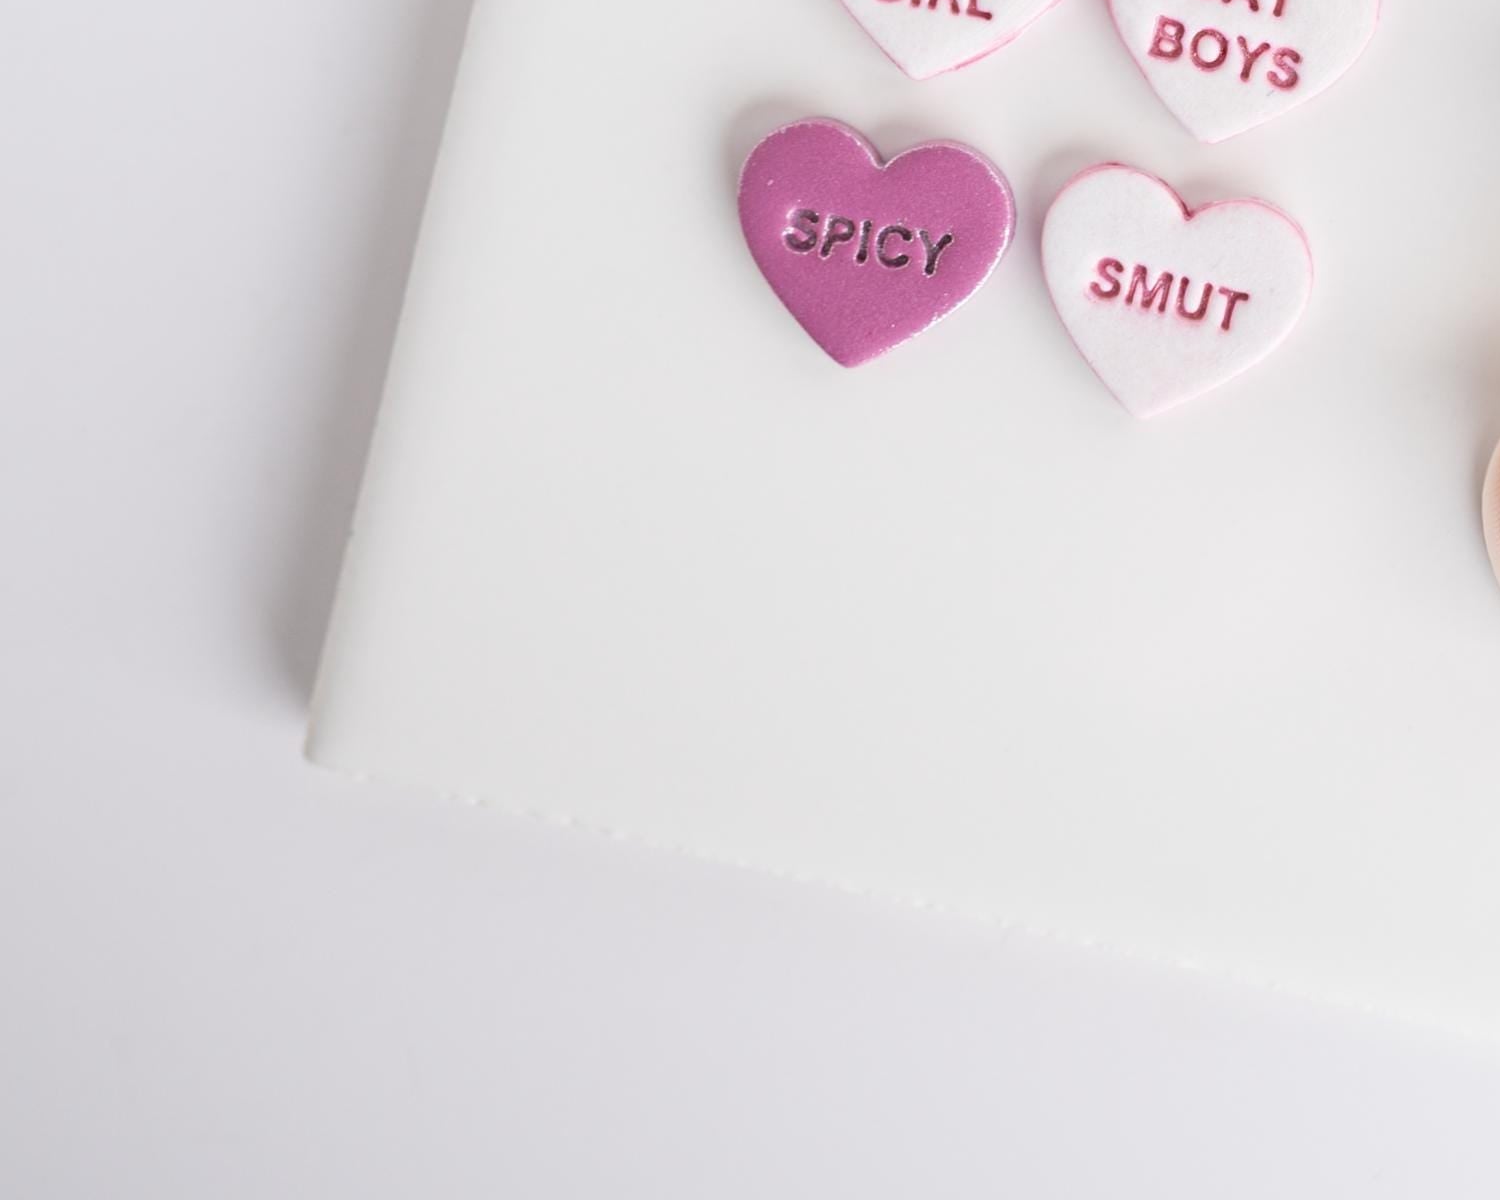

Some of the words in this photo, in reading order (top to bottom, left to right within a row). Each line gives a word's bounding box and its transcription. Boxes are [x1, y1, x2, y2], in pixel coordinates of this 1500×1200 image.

[1147, 14, 1303, 92] BOYS
[782, 207, 956, 278] SPICY
[1087, 256, 1250, 332] SMUT
